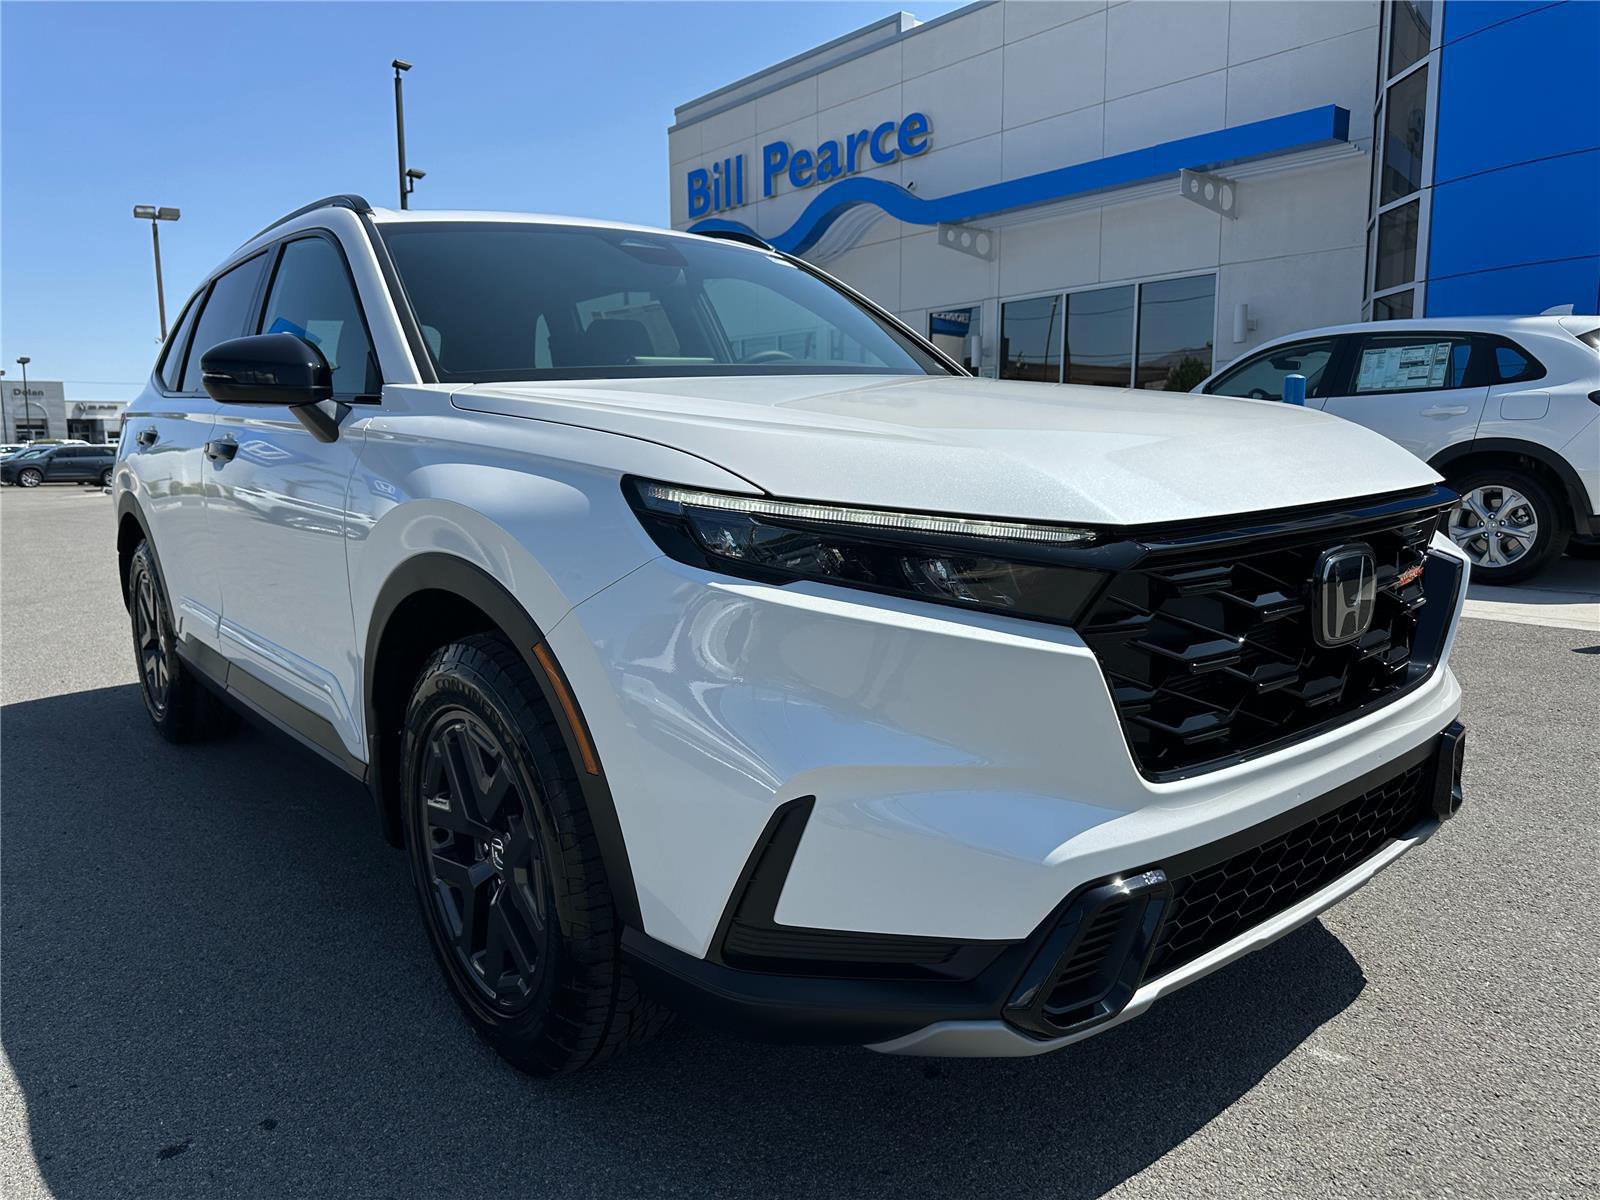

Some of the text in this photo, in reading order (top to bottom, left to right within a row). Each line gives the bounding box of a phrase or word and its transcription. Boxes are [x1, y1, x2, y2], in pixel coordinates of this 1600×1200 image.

[687, 112, 929, 219] Bill Pearce
[13, 388, 44, 396] Dolan
